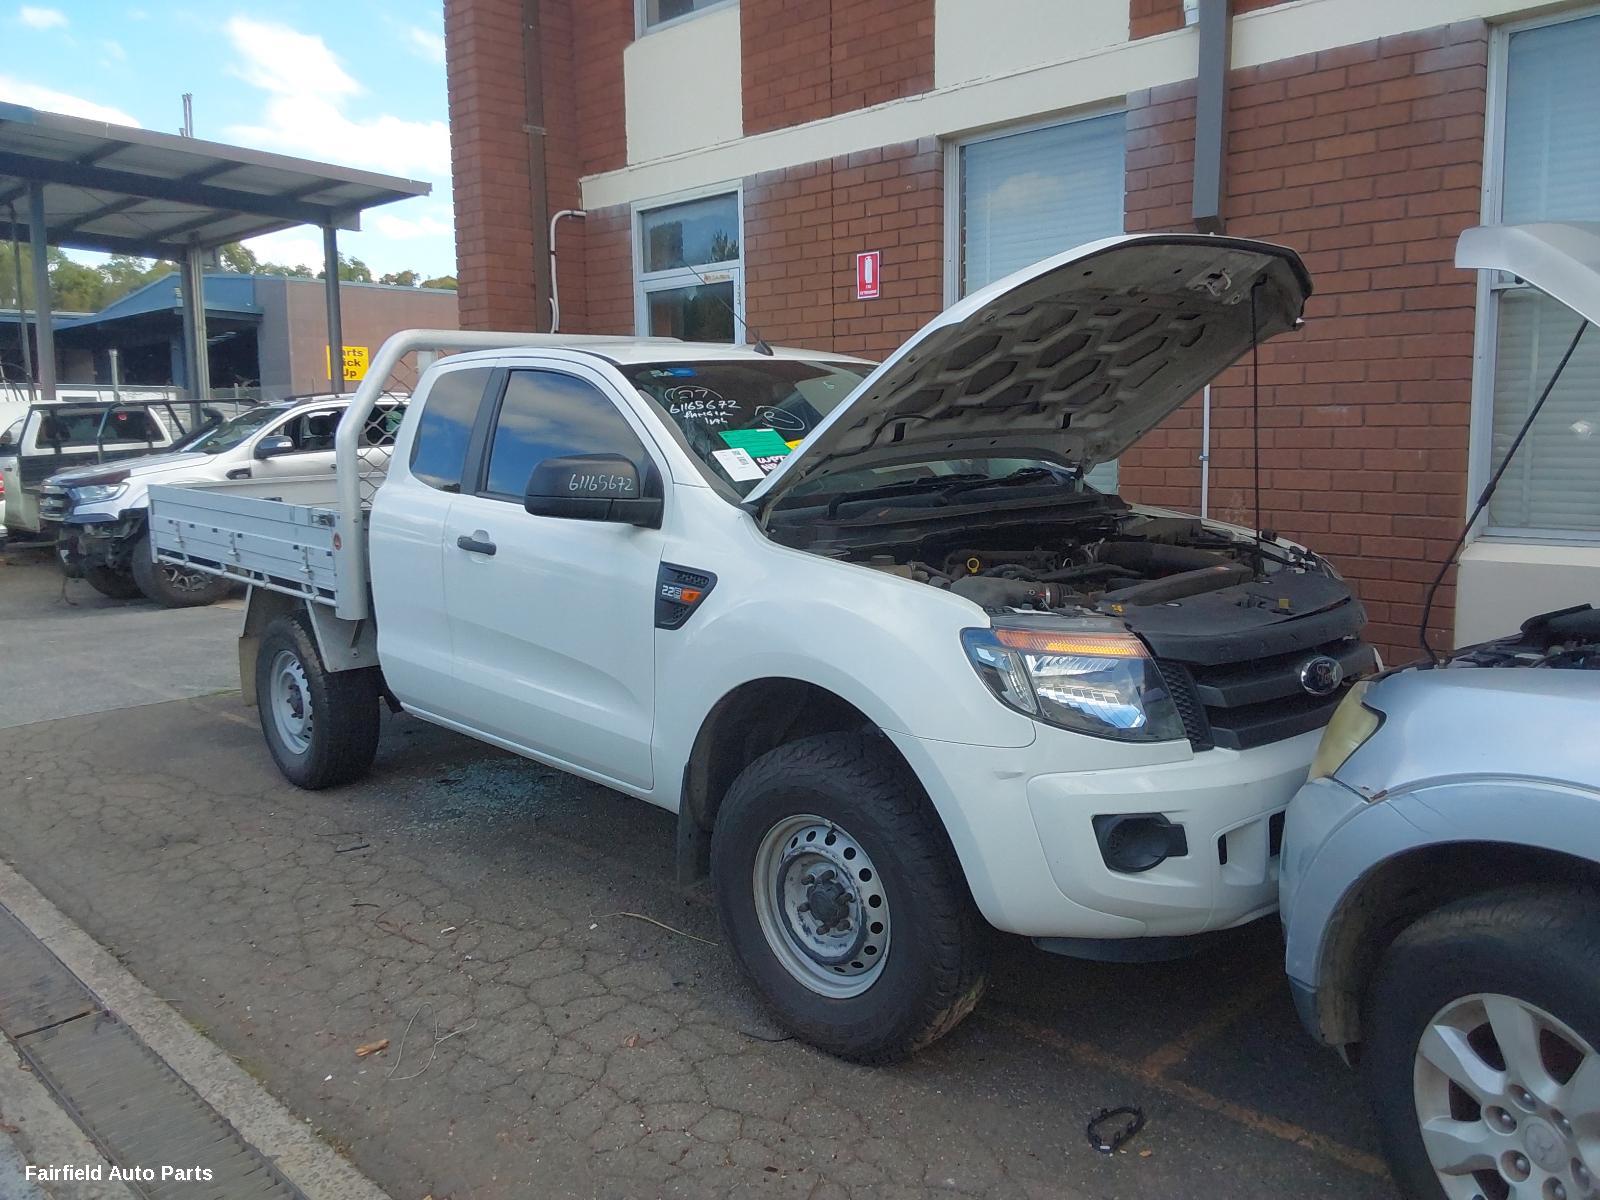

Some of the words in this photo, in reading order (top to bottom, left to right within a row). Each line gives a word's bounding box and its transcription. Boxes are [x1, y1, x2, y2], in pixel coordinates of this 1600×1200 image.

[342, 349, 363, 357] arts
[343, 359, 361, 367] ick
[669, 400, 741, 413] 61165672
[568, 474, 633, 492] 61165672
